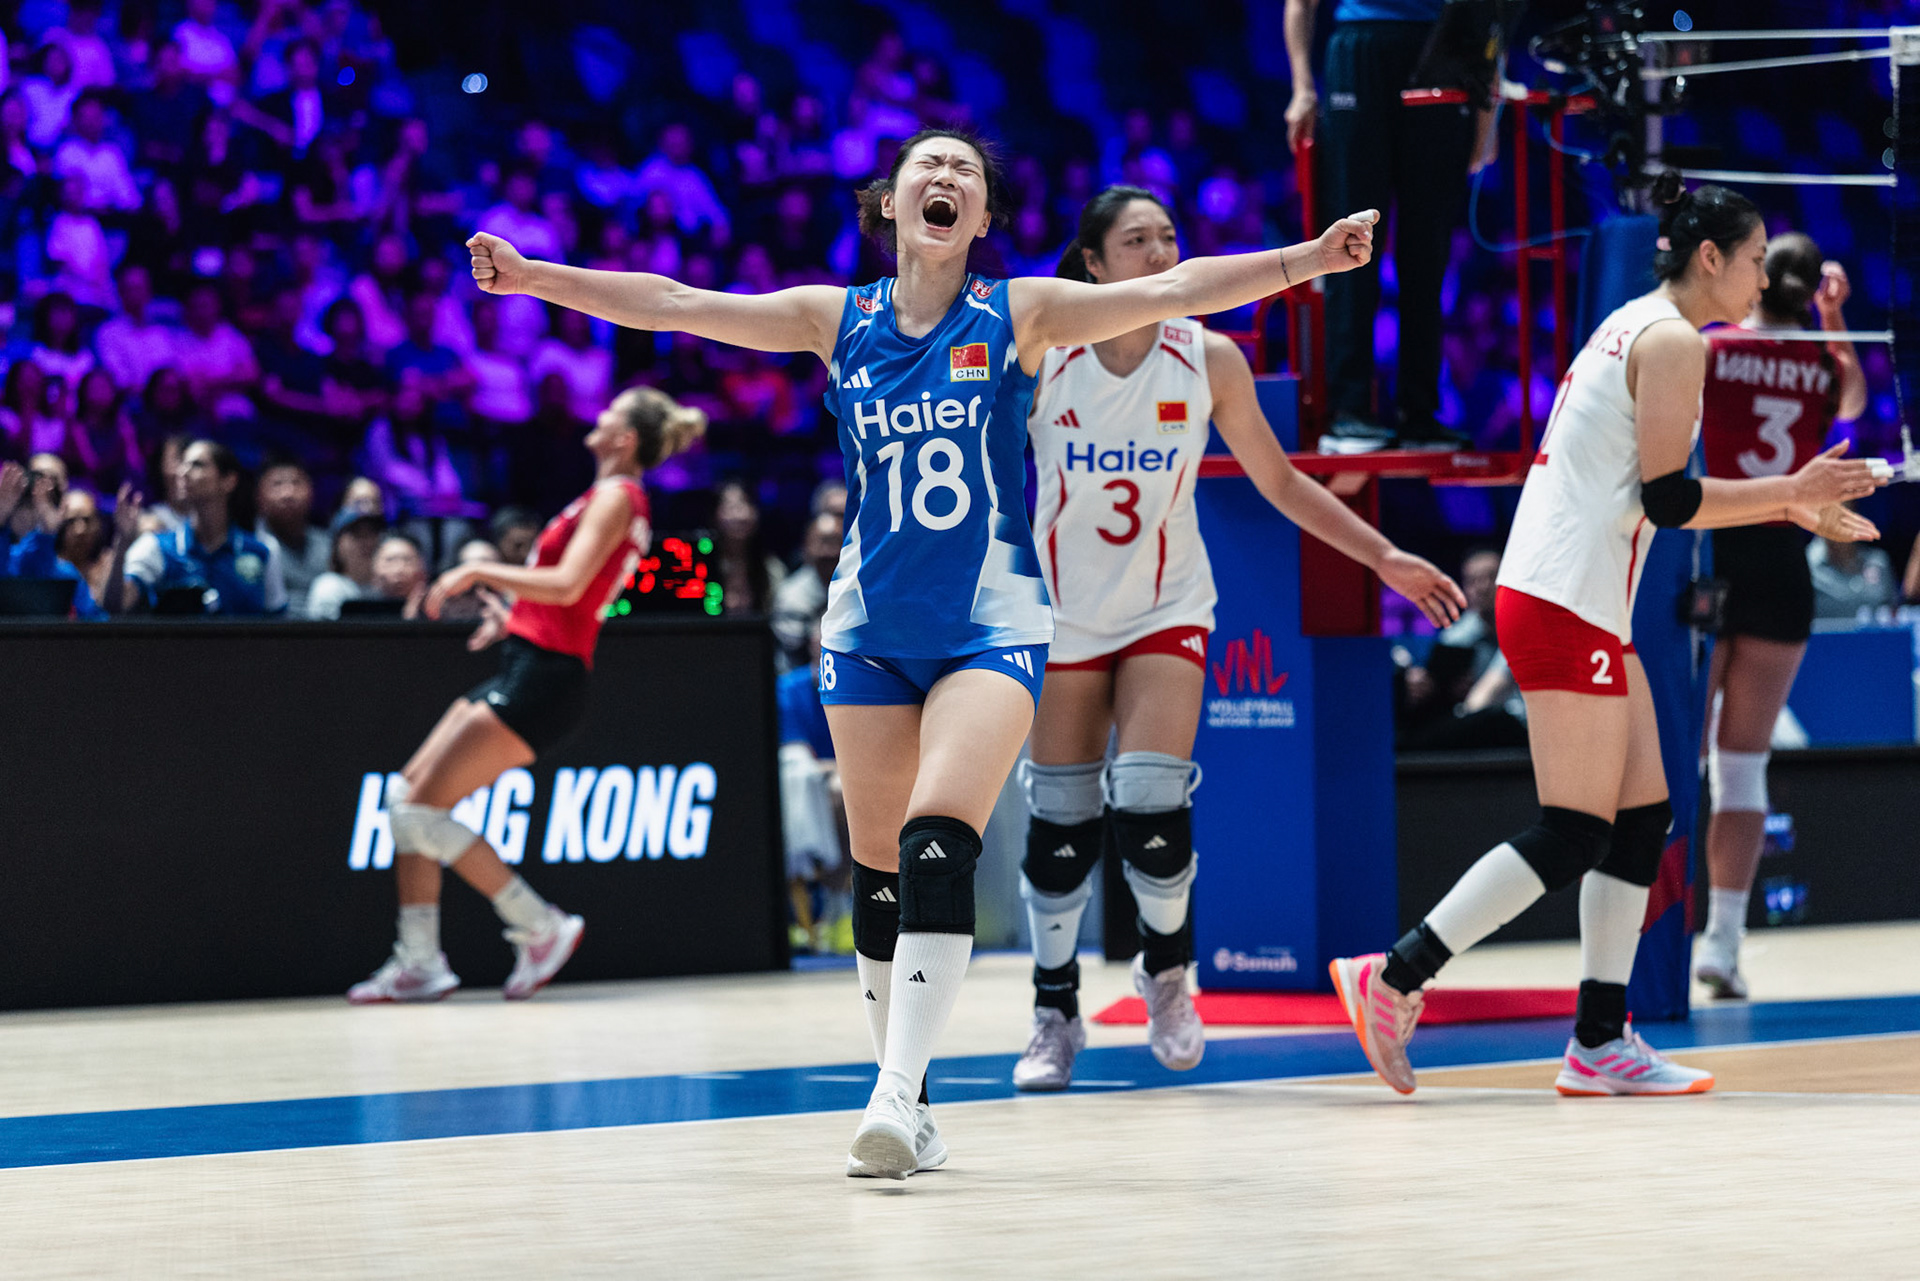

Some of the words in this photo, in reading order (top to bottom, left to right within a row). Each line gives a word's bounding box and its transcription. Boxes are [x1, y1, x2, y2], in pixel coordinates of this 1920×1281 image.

[955, 368, 985, 379] CHN
[853, 391, 982, 440] Haier
[1737, 394, 1803, 478] 3
[876, 437, 972, 533] 18
[1066, 440, 1179, 473] Haier
[1096, 478, 1142, 547] 3
[1212, 627, 1289, 696] VNL
[1590, 649, 1613, 685] 2
[542, 762, 718, 864] KONG
